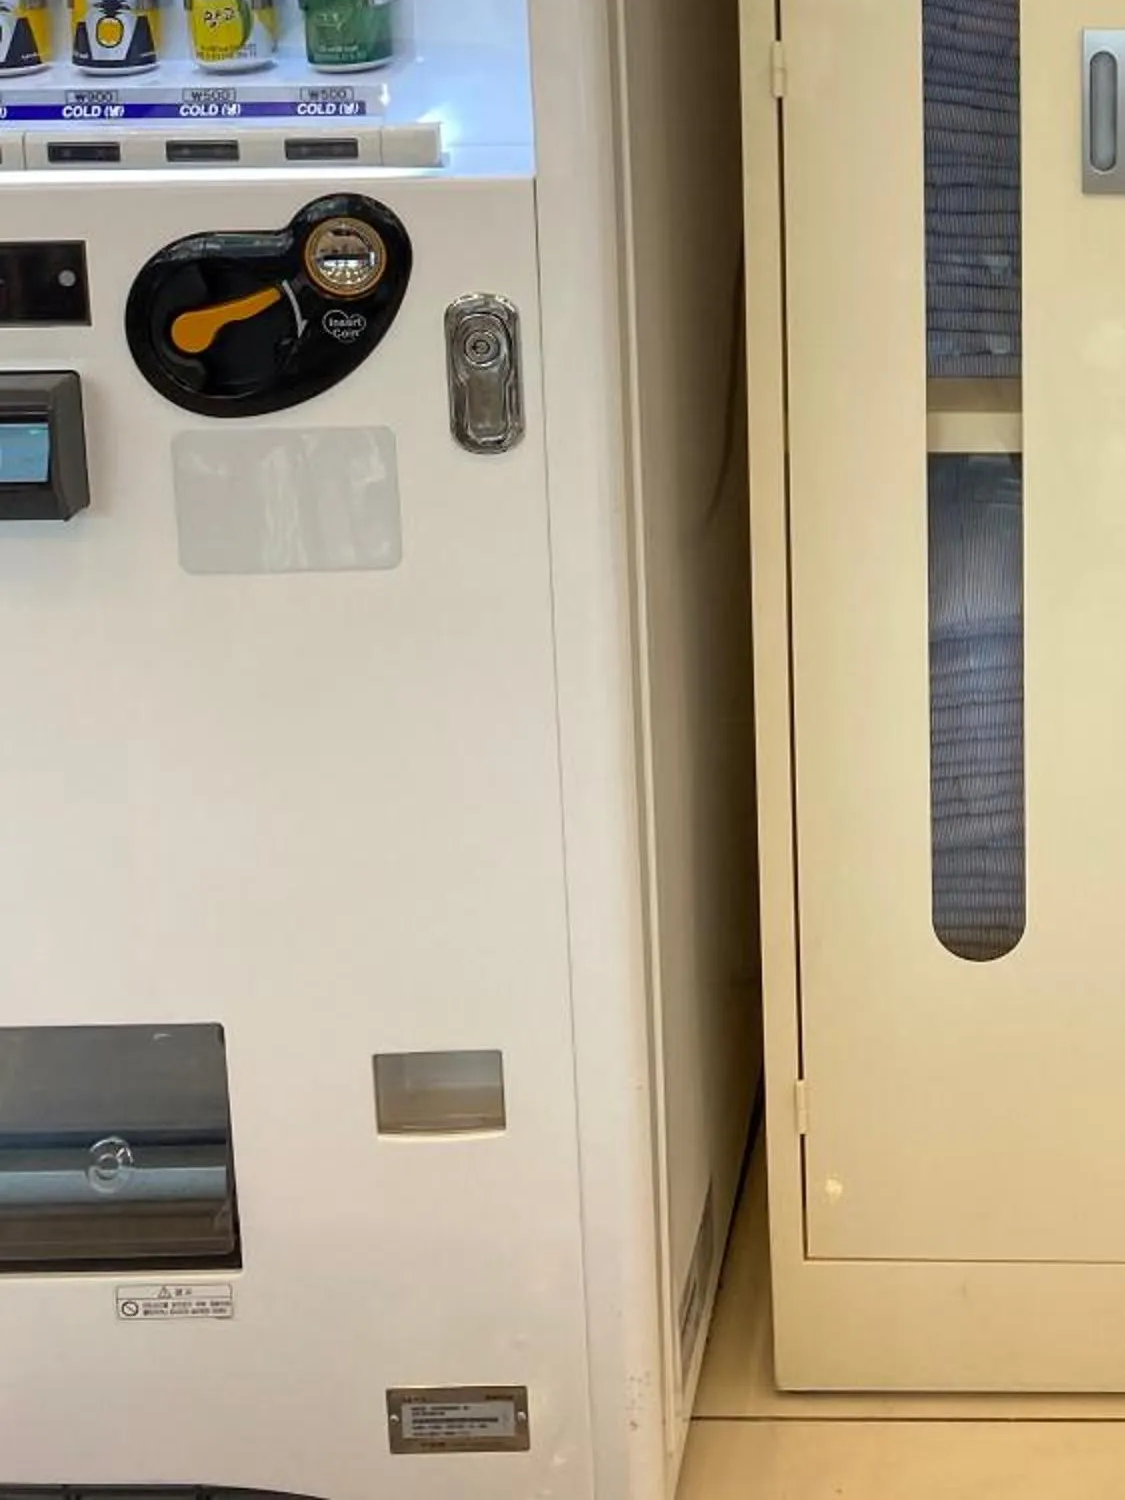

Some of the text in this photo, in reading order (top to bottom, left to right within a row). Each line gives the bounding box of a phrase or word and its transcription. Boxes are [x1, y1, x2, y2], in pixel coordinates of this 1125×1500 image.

[62, 105, 100, 118] COLD
[179, 104, 219, 116] COLD
[297, 103, 337, 115] COLD
